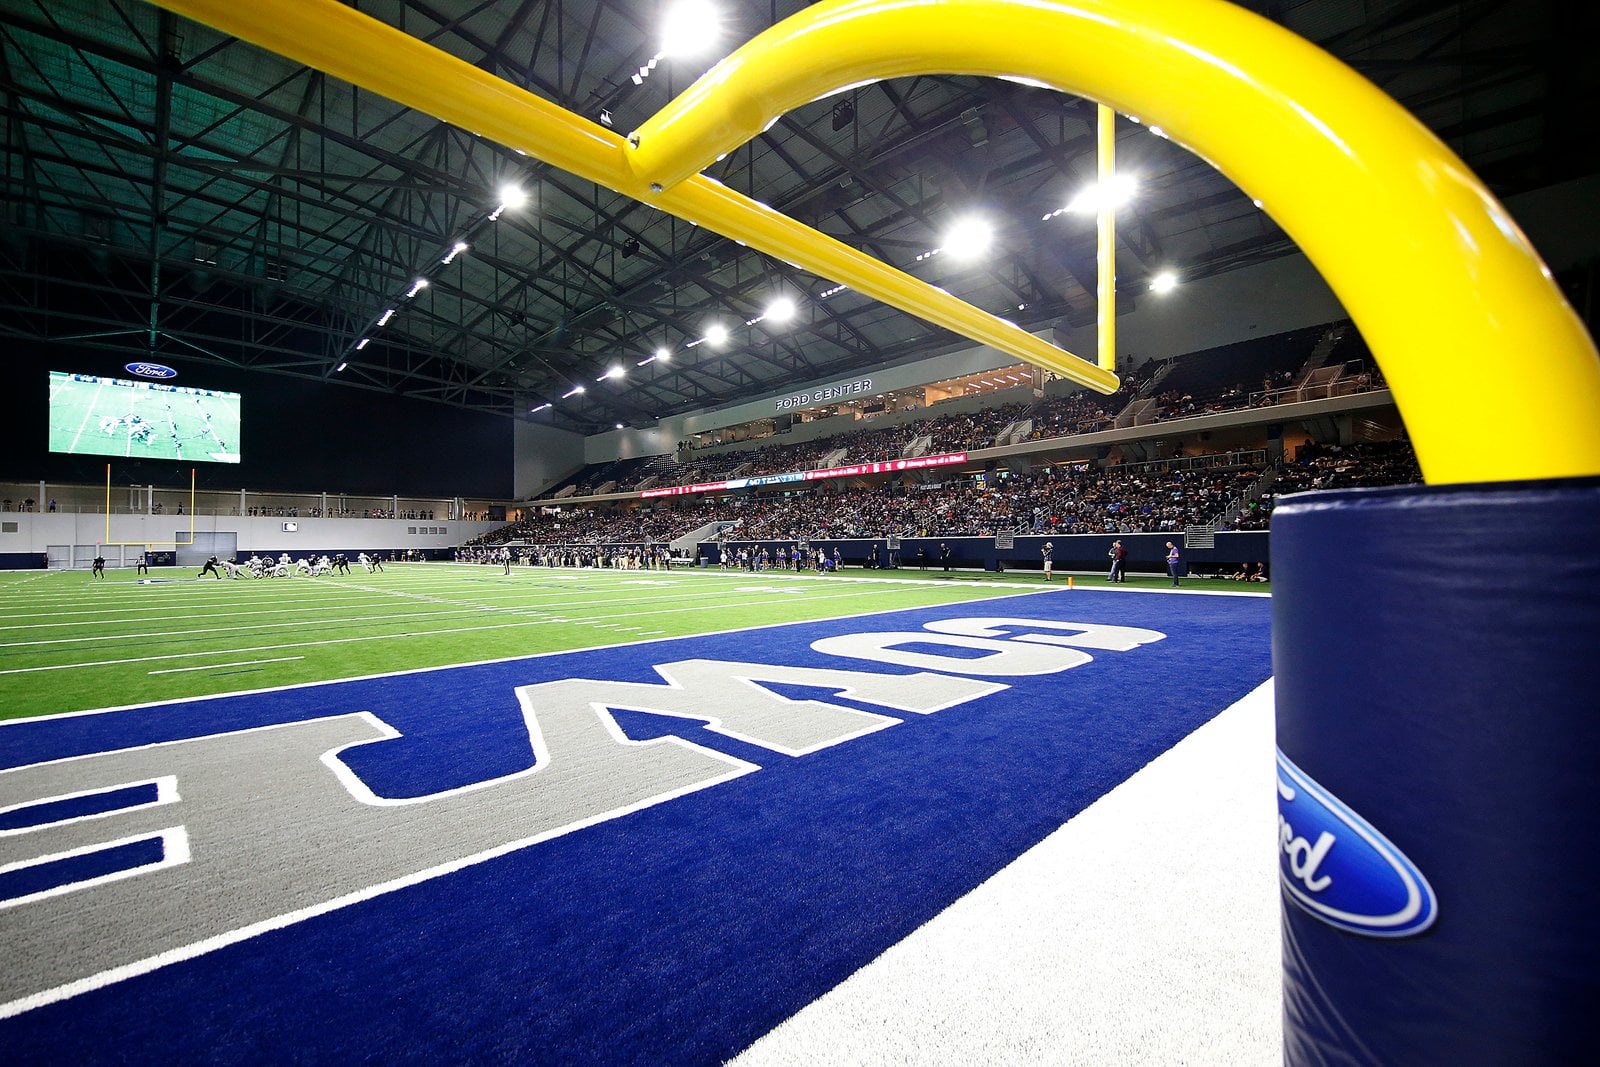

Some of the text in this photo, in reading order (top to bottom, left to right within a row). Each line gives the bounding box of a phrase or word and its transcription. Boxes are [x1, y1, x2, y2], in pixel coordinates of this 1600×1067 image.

[135, 364, 168, 377] Ford
[775, 378, 872, 411] FORD CENTER
